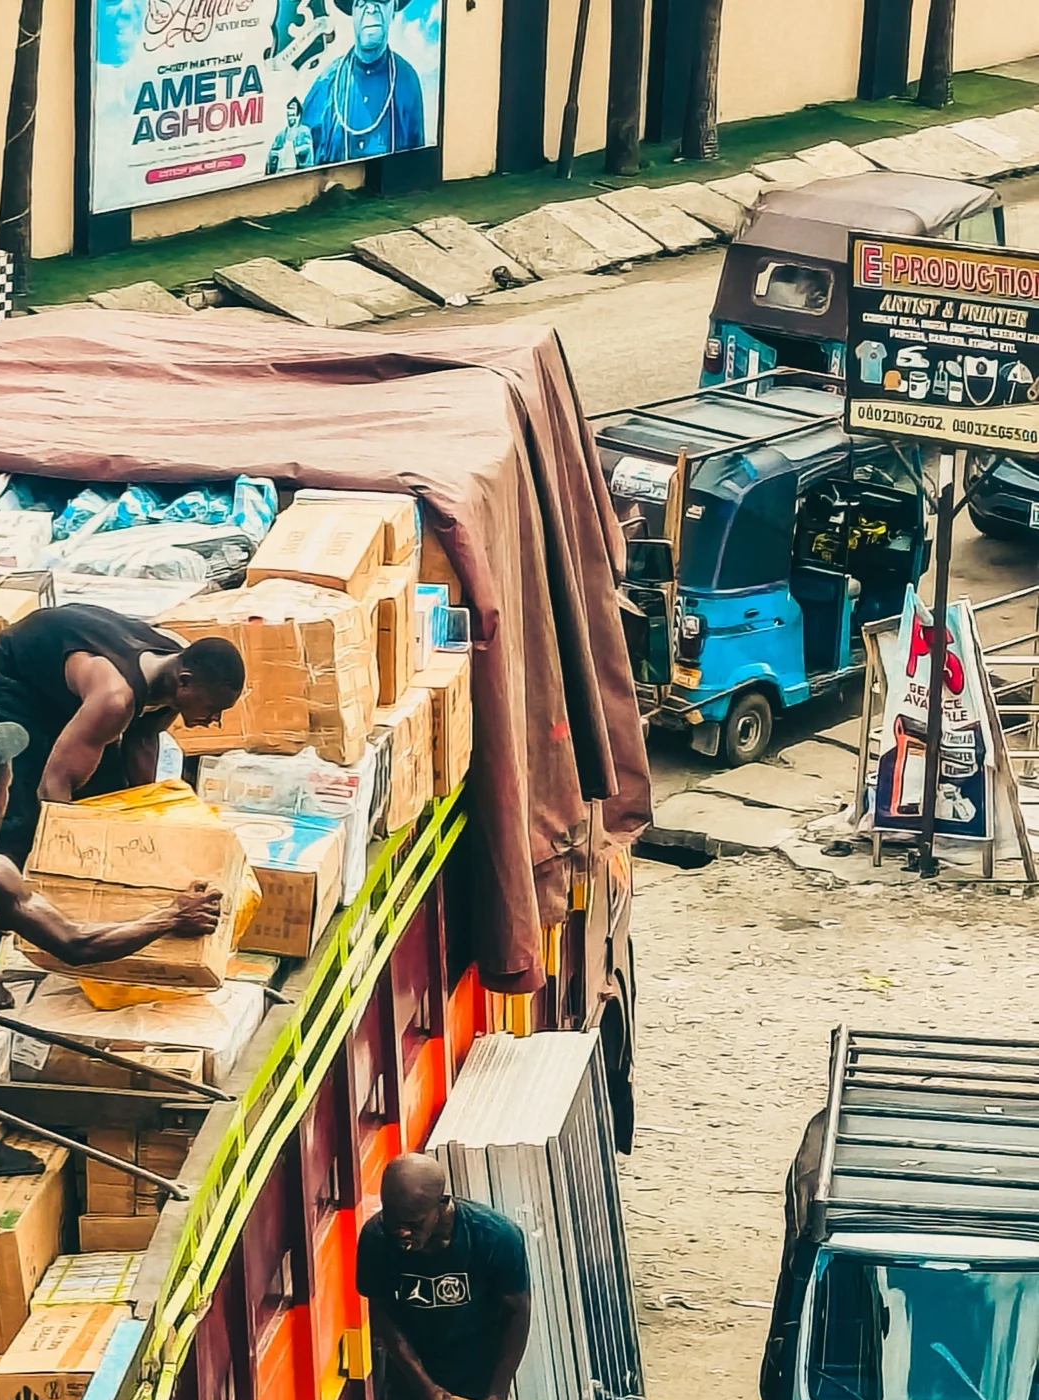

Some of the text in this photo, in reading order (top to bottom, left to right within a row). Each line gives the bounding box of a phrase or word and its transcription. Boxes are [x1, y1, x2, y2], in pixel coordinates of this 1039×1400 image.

[189, 52, 243, 69] MATTHEW
[133, 65, 263, 115] AMETA
[132, 96, 263, 145] AGHOMI
[861, 243, 1039, 300] E-PRODUCTIO
[879, 294, 940, 317] ARTIST
[957, 303, 1029, 328] PRINTER
